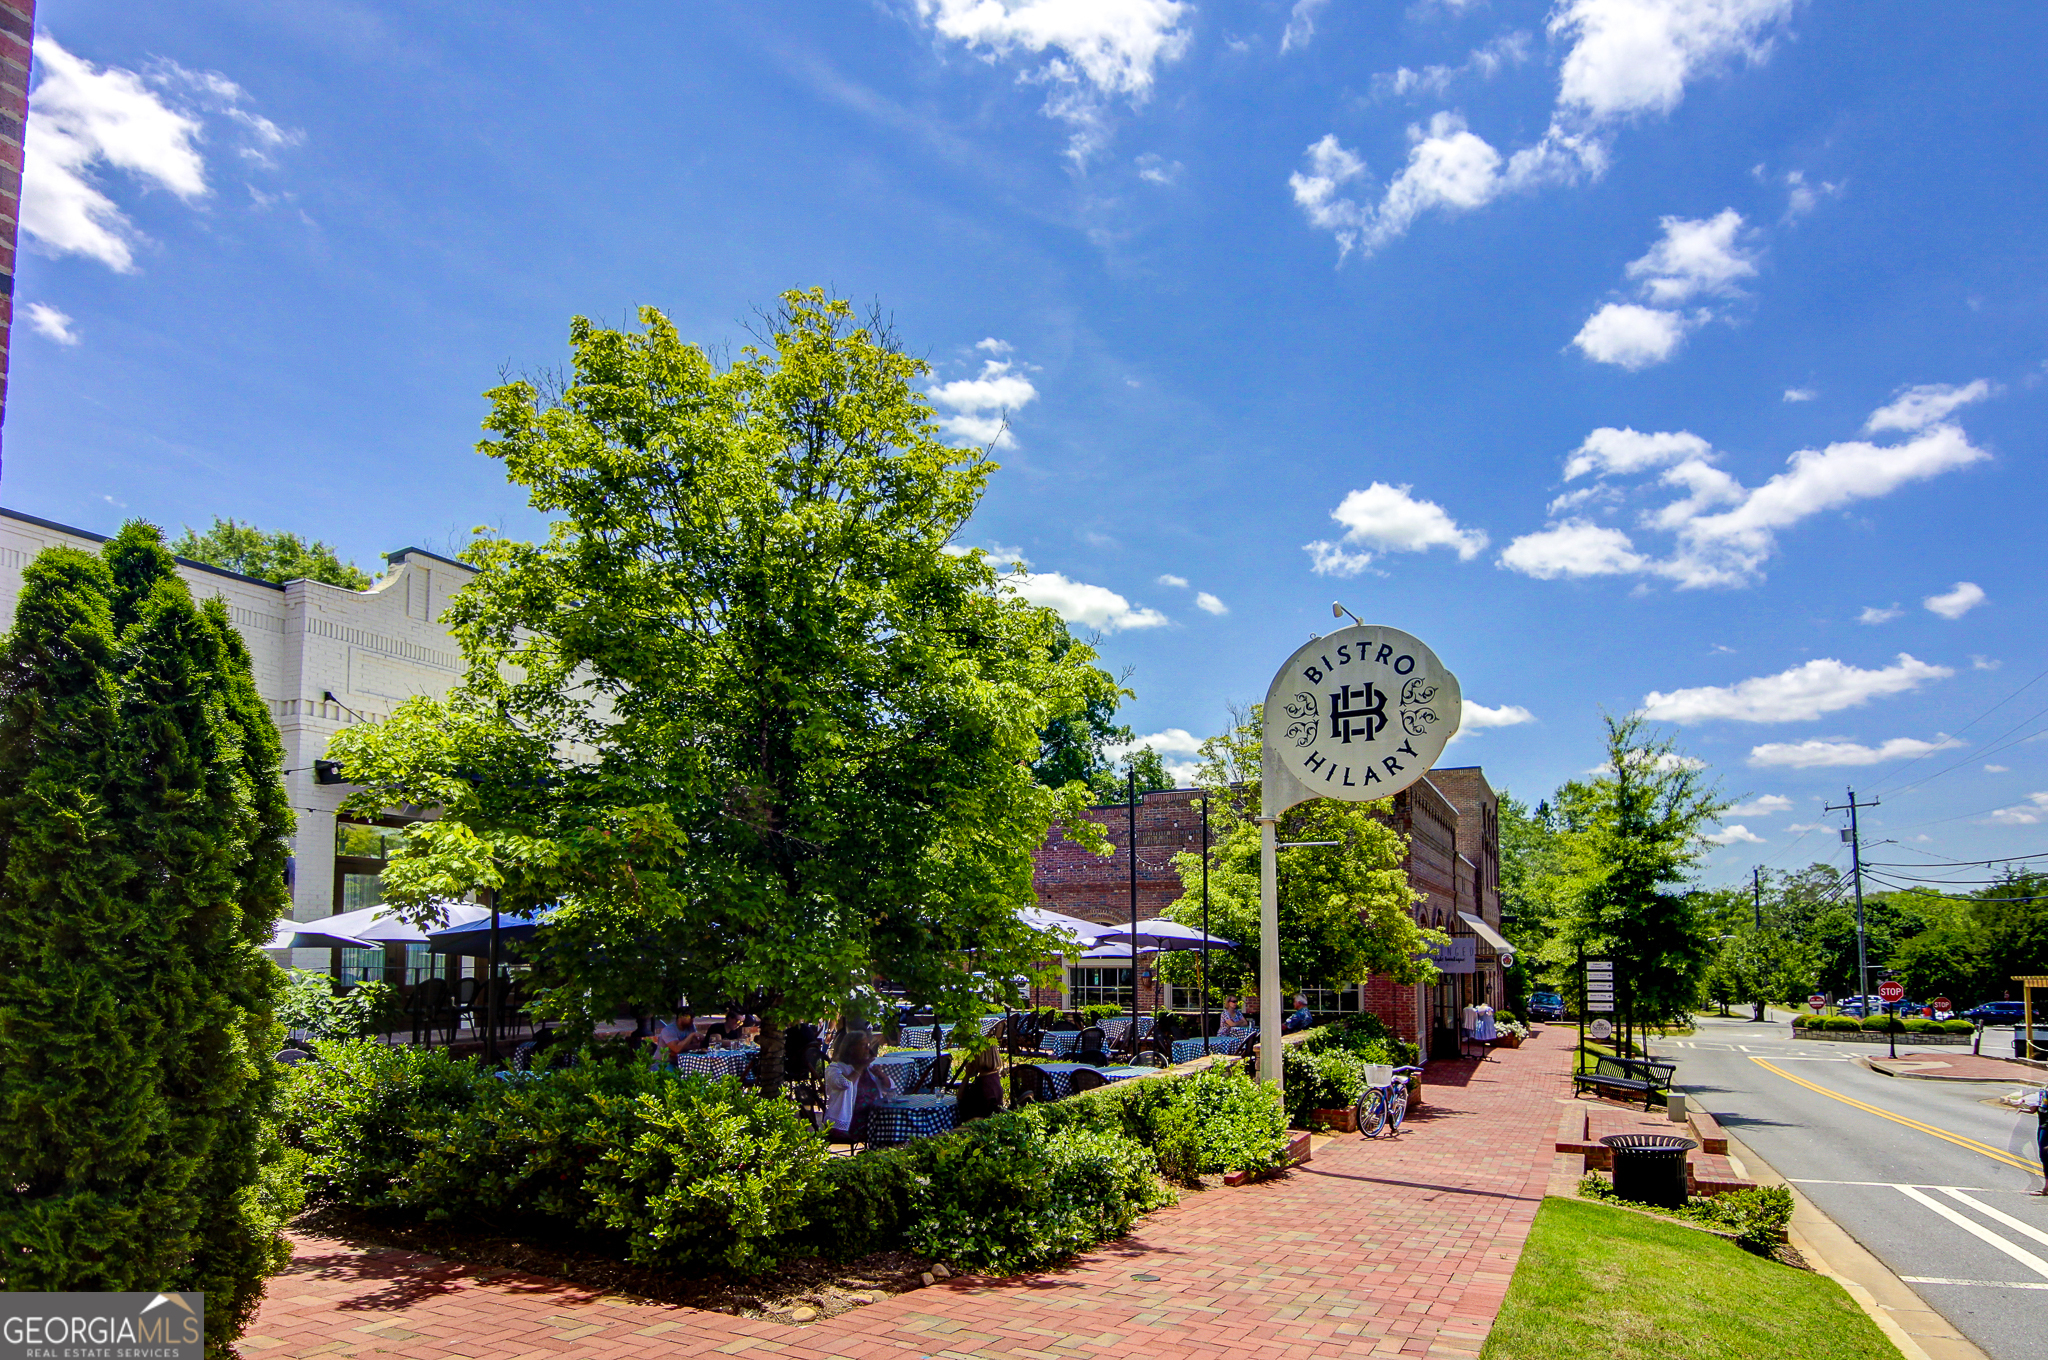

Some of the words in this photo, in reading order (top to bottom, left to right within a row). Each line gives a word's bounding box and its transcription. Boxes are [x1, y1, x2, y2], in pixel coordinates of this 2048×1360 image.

[1303, 641, 1415, 685] BISTRO
[1303, 738, 1419, 787] HILARY
[1880, 987, 1902, 996] STOP
